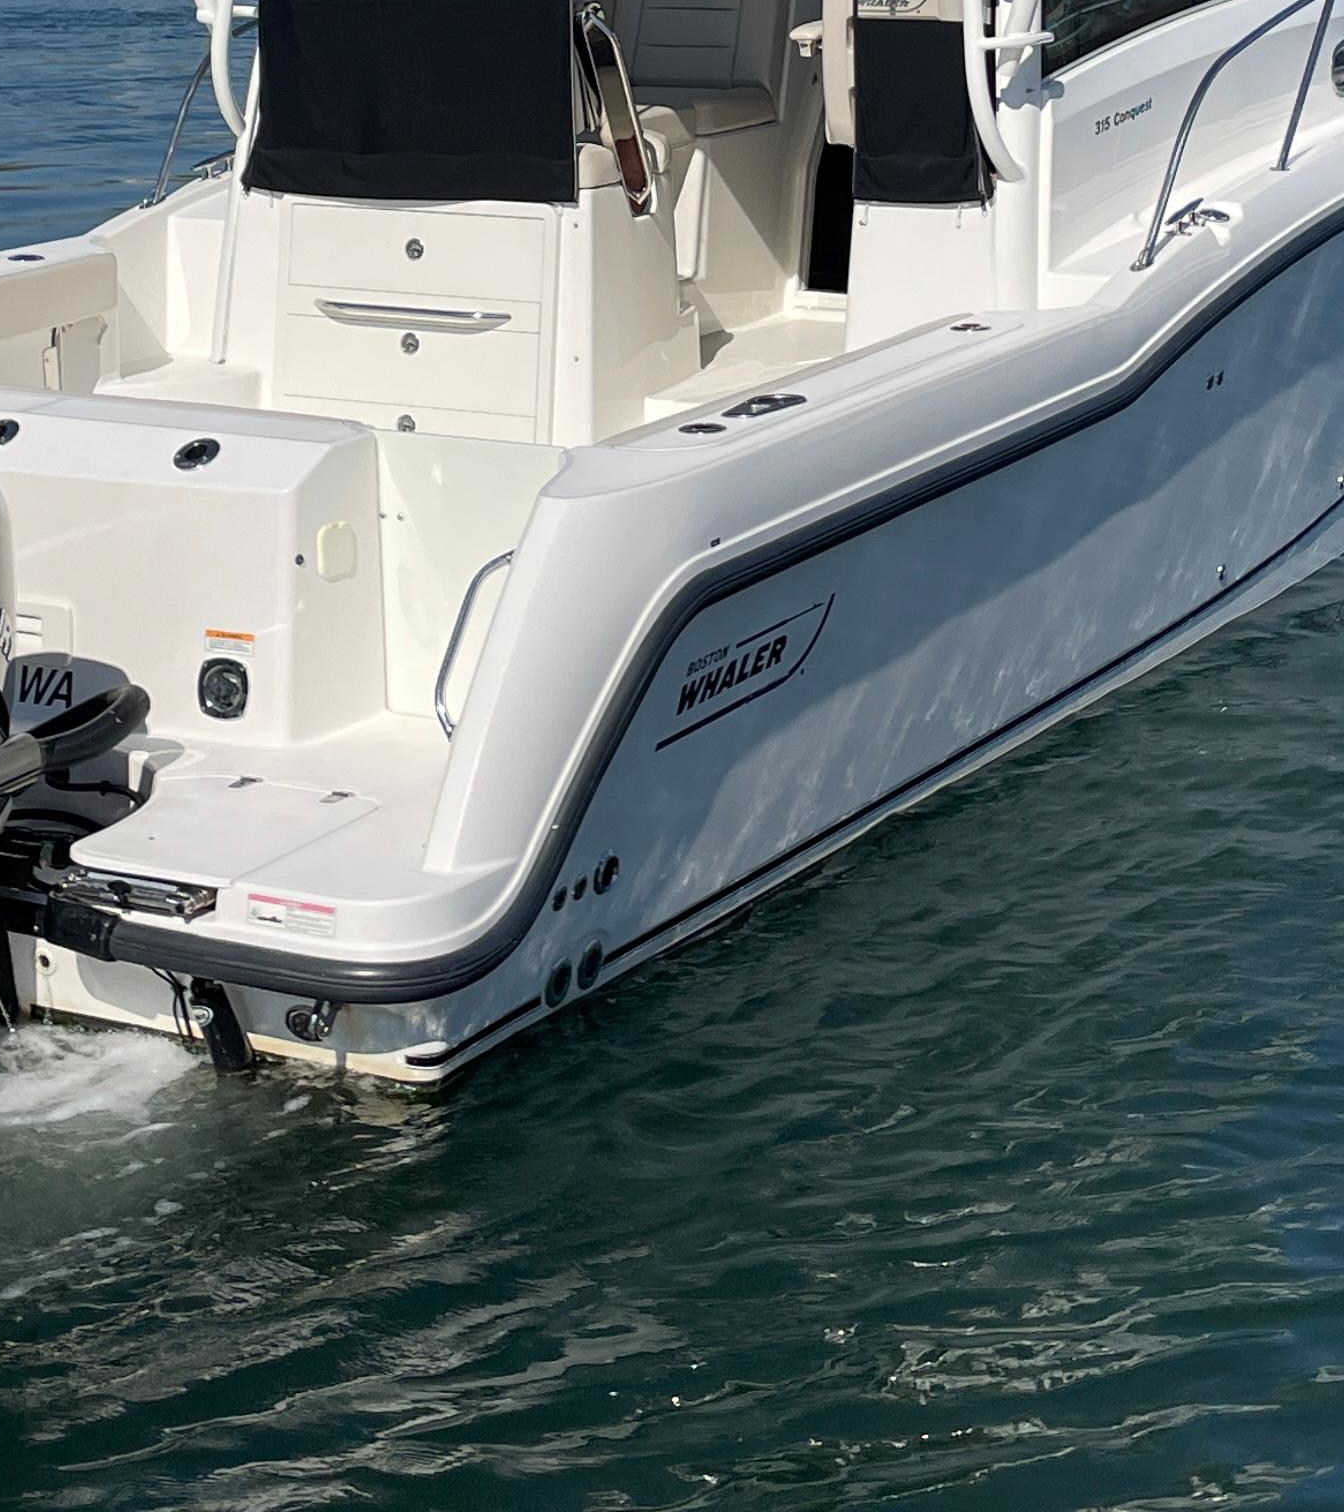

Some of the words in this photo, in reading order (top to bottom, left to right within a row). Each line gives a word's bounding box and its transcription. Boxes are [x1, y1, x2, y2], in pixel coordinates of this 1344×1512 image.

[1095, 115, 1111, 135] 315
[1113, 97, 1153, 126] Conquest
[676, 634, 788, 716] WHALER
[686, 644, 731, 677] BOSTON
[18, 665, 74, 709] WA
